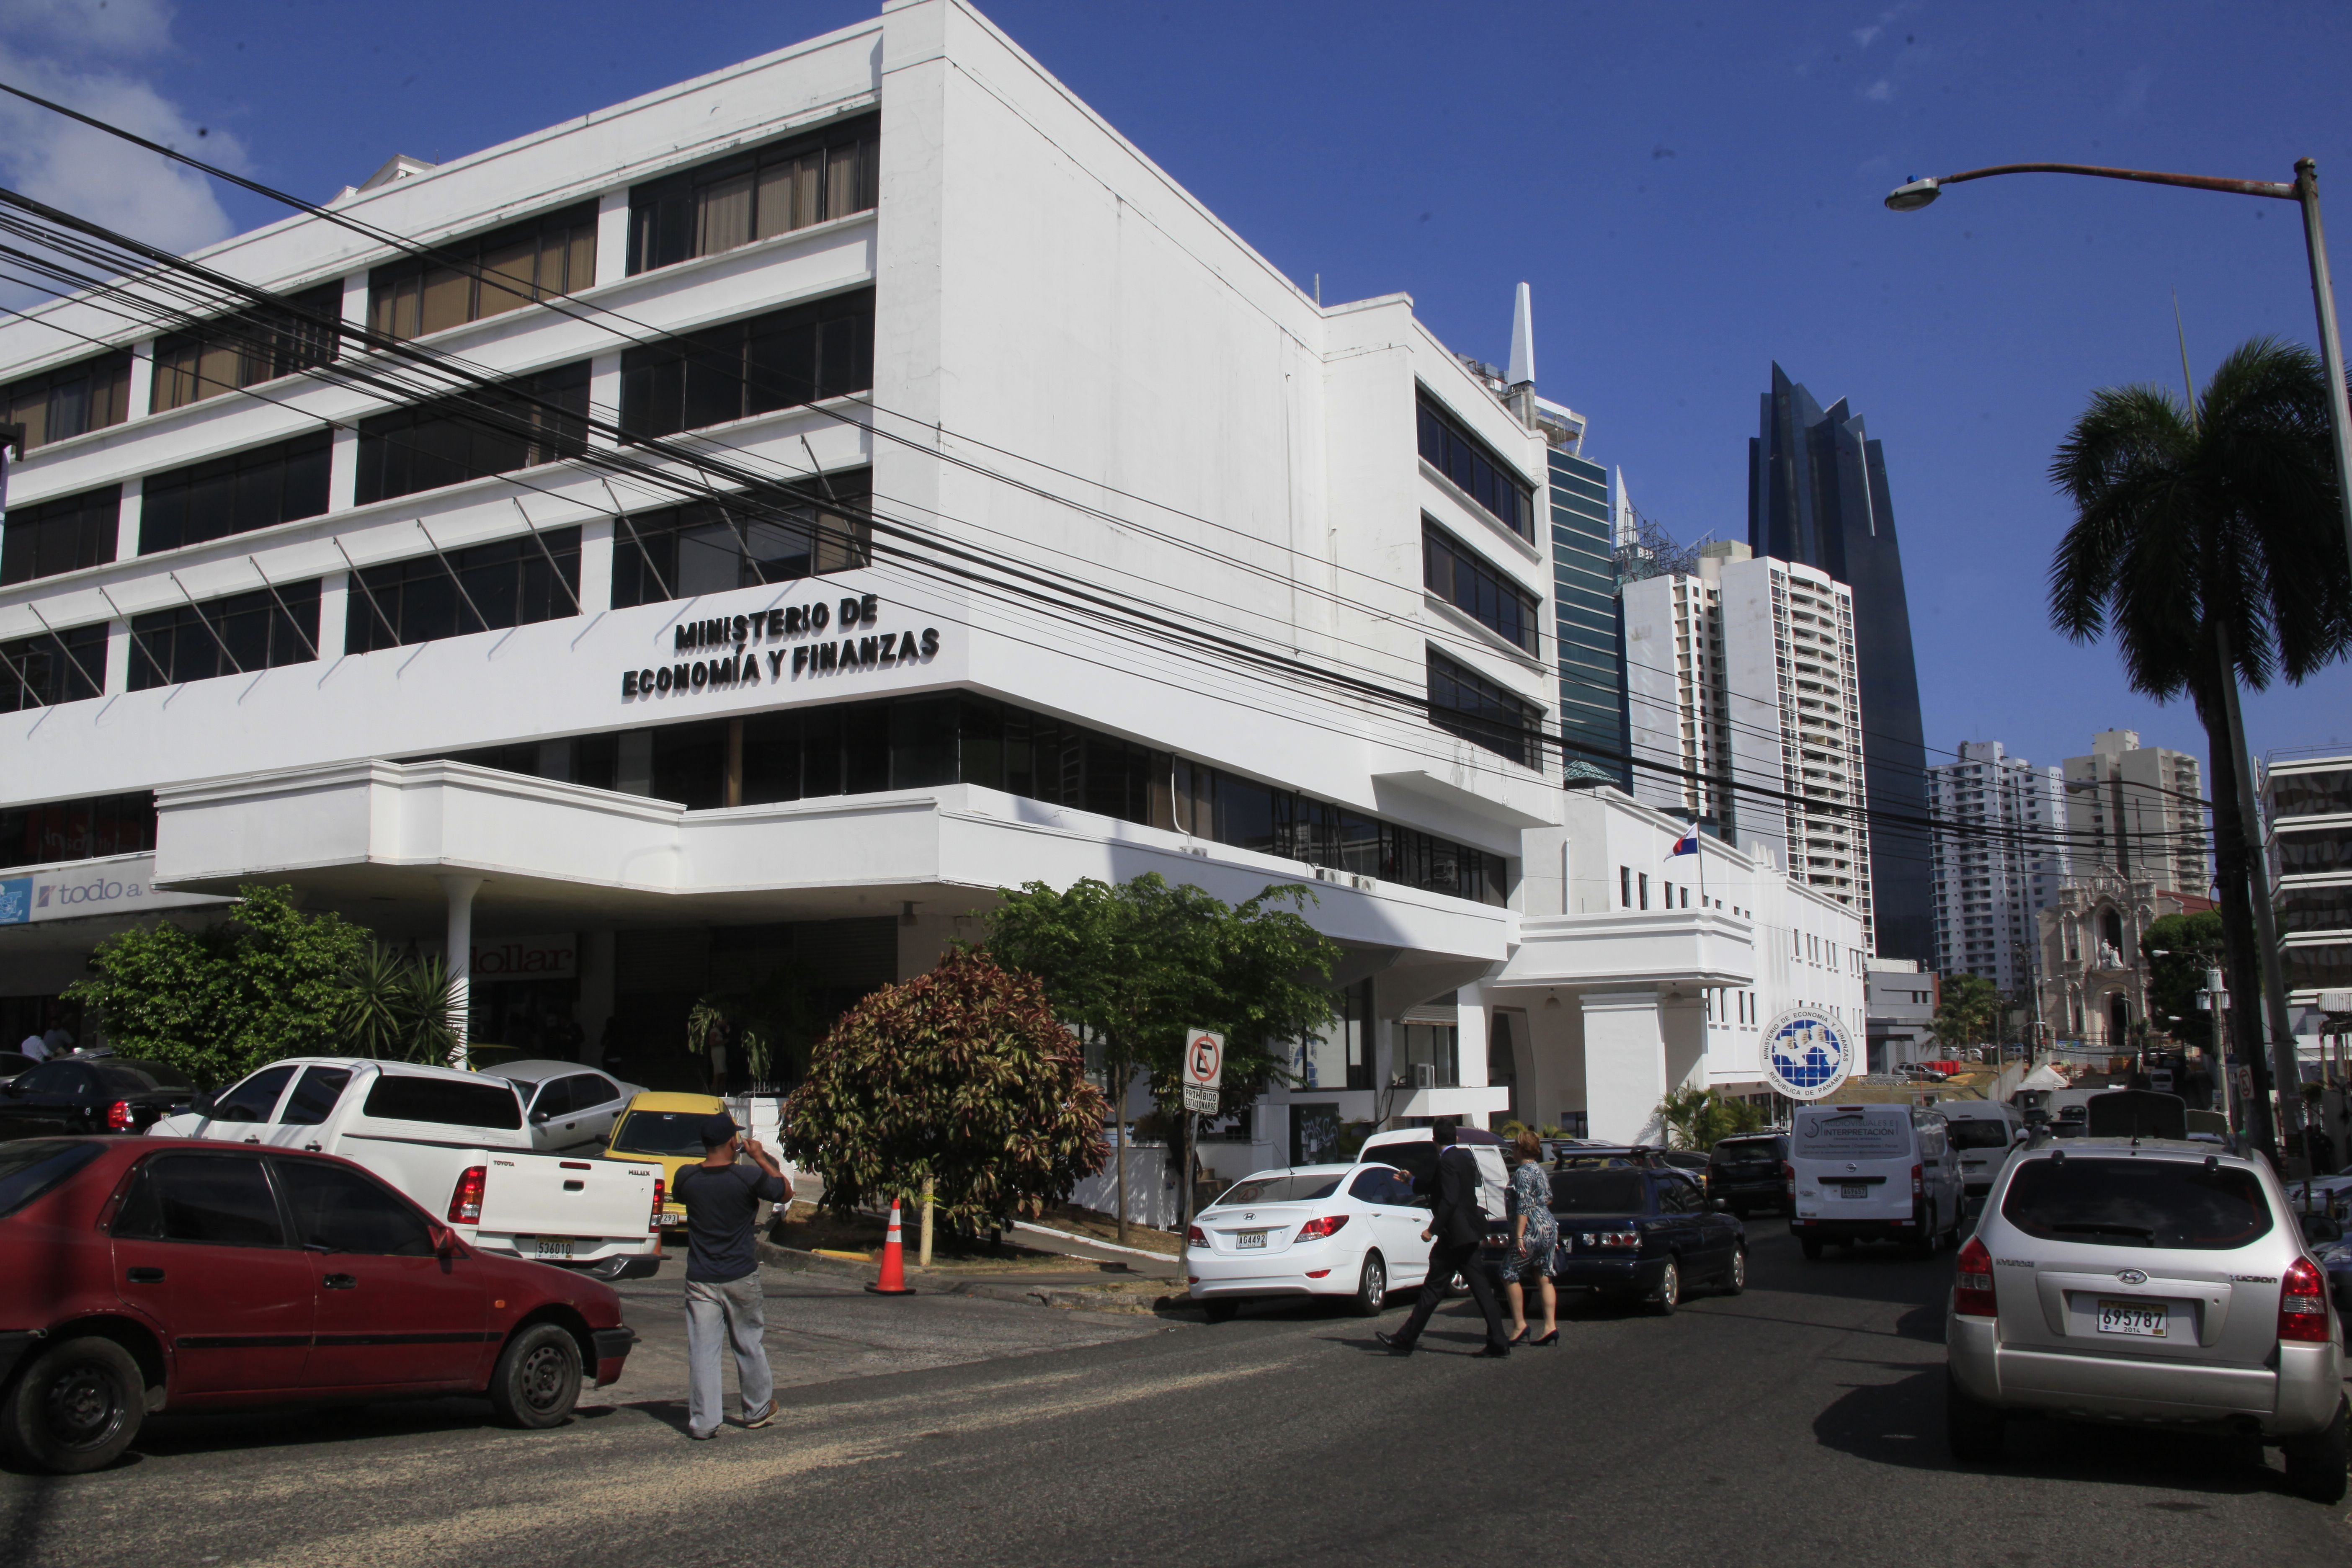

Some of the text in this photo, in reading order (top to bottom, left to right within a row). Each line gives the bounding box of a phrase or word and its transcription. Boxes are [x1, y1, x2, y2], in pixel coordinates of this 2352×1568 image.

[675, 593, 878, 650] MINISTERIO DE
[622, 627, 941, 697] ECONOMÍA Y FINANZAS
[59, 878, 122, 904] todo
[126, 883, 143, 897] a
[1763, 1024, 1779, 1060] MINISTERIO
[1793, 1011, 1828, 1023] ECONOMIA
[1836, 1029, 1849, 1062] FINANZAS
[1769, 1071, 1800, 1095] REPUBLICA
[1818, 1073, 1843, 1093] PANAMA
[1186, 1089, 1216, 1101] PROHIBIDO
[1186, 1097, 1216, 1111] ESTACIONARSE
[539, 1242, 570, 1254] 536010
[1239, 1235, 1265, 1244] AG4492
[1996, 1259, 2035, 1268] HYUNDAI
[2103, 1308, 2162, 1328] 695787
